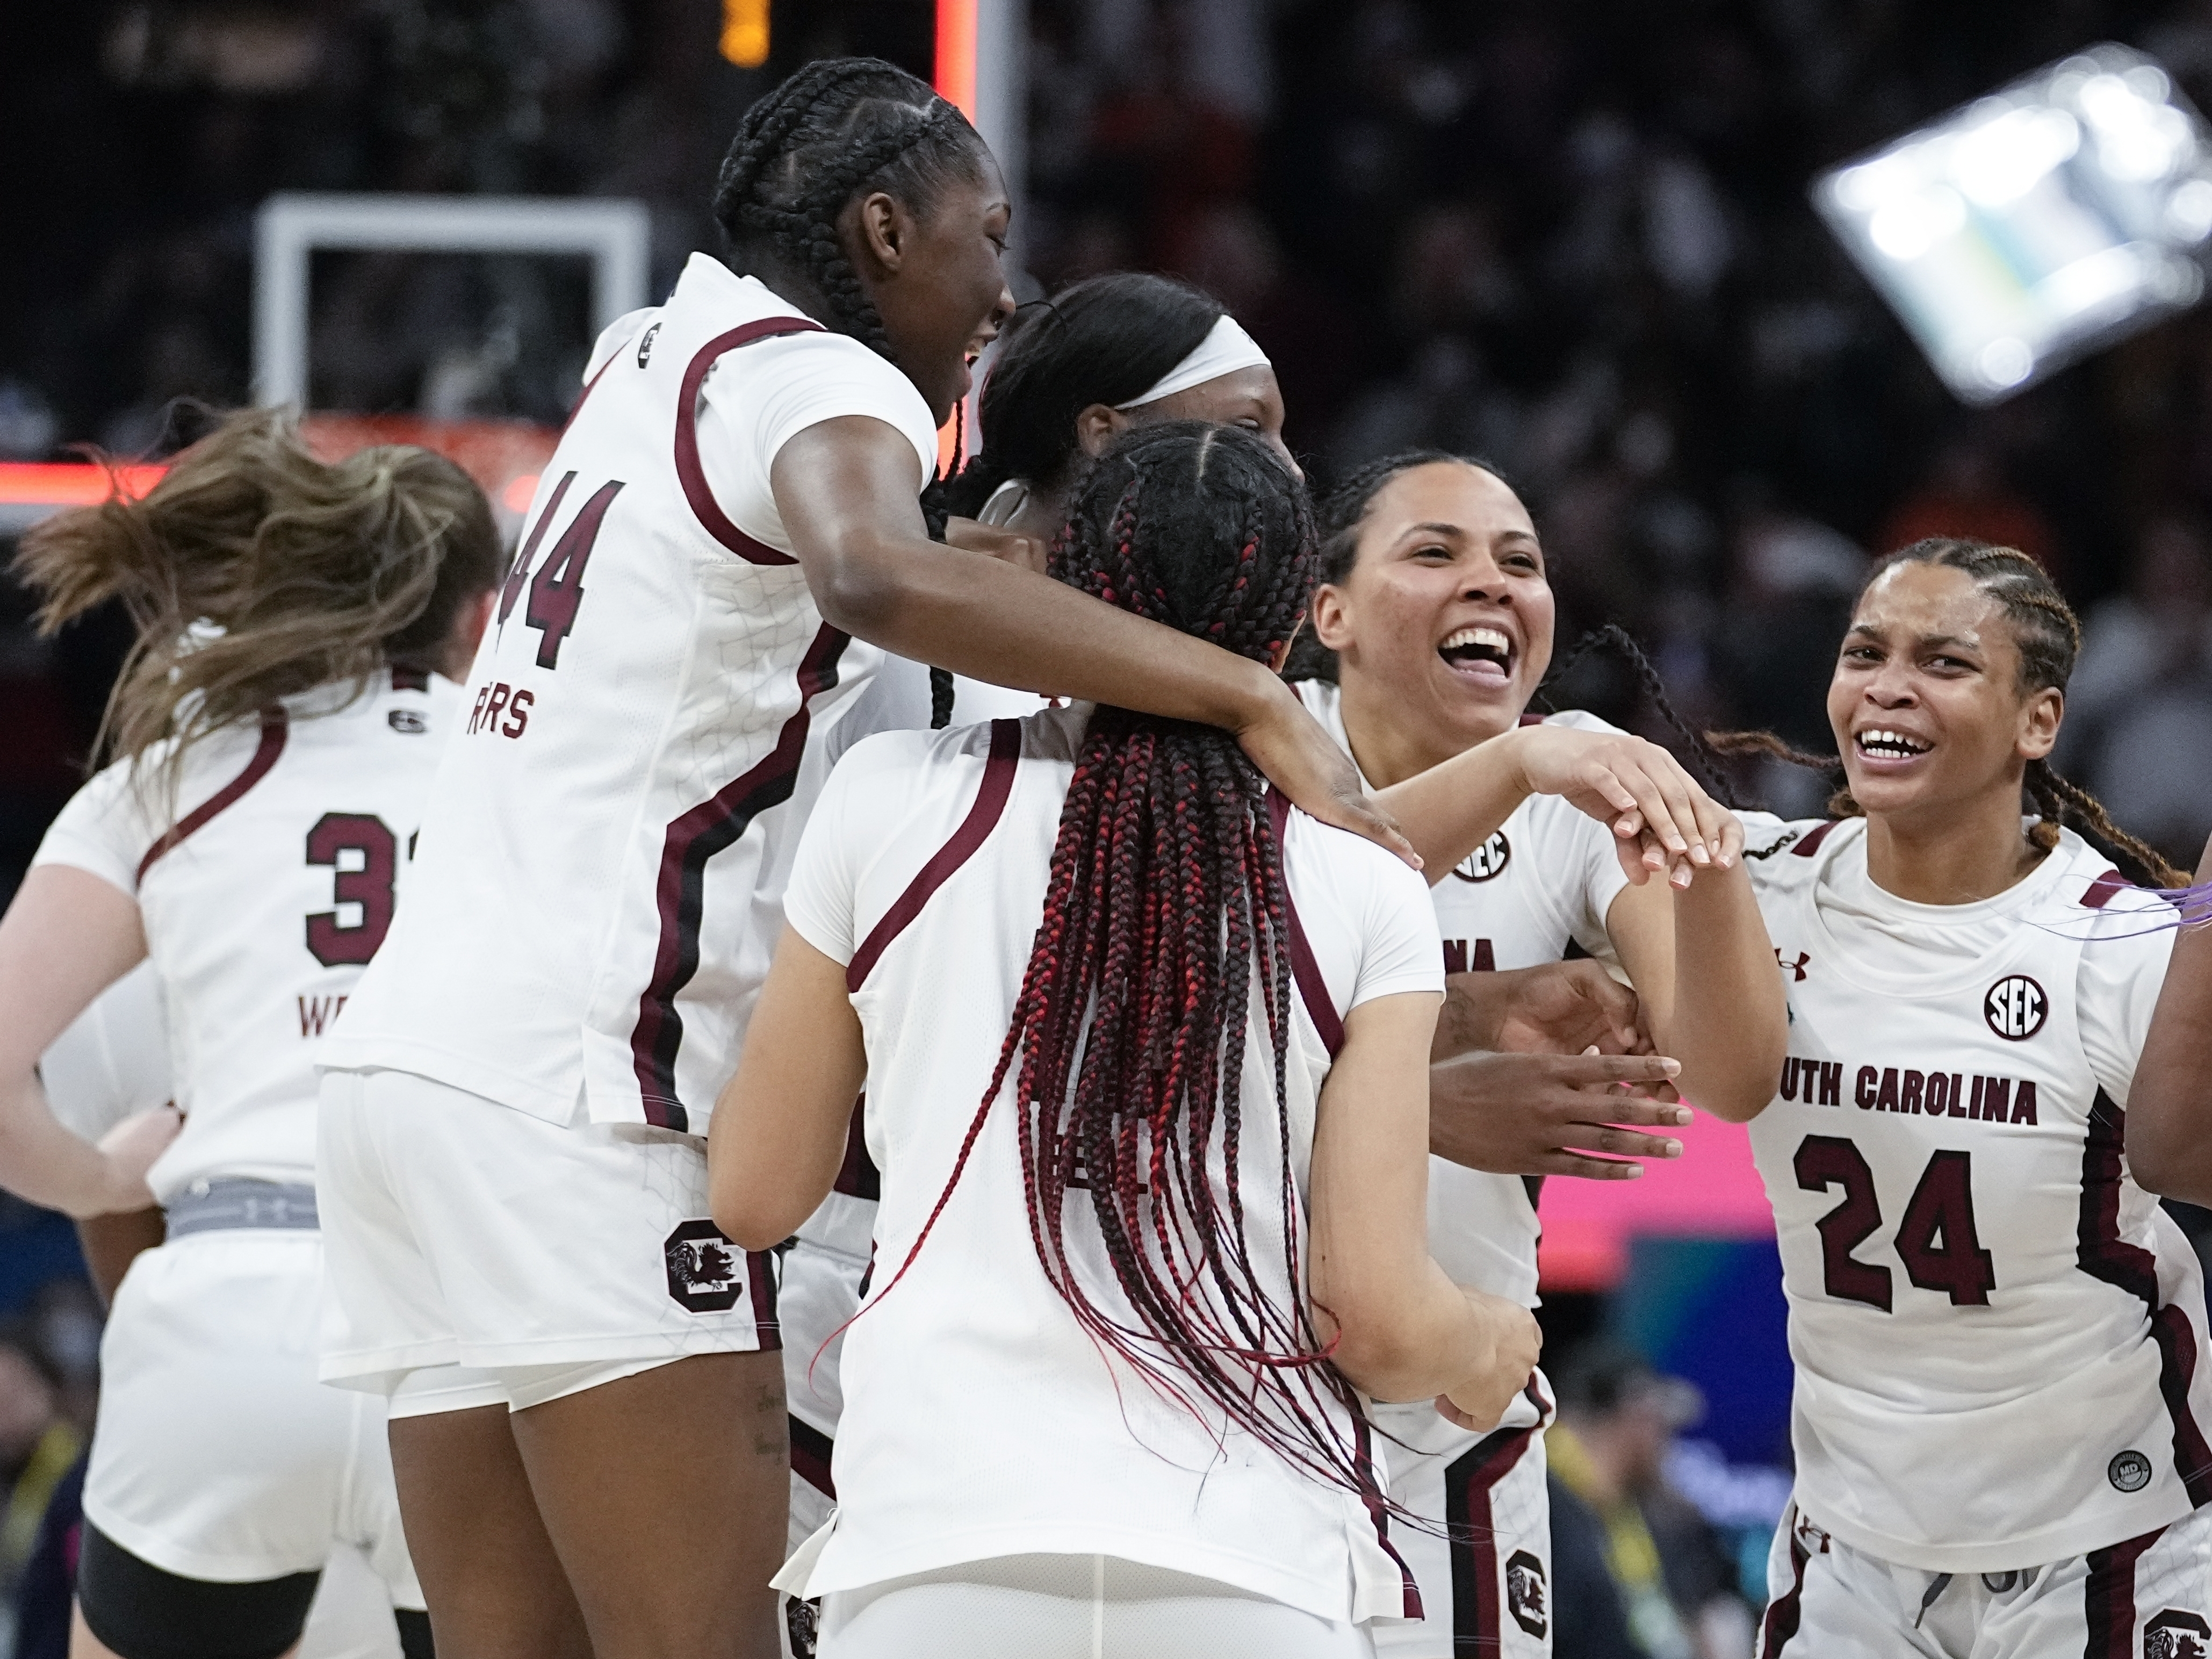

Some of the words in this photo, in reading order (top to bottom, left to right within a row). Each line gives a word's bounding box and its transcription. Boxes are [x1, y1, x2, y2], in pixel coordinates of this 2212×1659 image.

[306, 812, 420, 967] 3
[1989, 978, 2042, 1037] SEC
[1780, 1057, 1843, 1107] UTH
[1855, 1066, 2038, 1126] CAROLINA
[1793, 1134, 1996, 1314] 24
